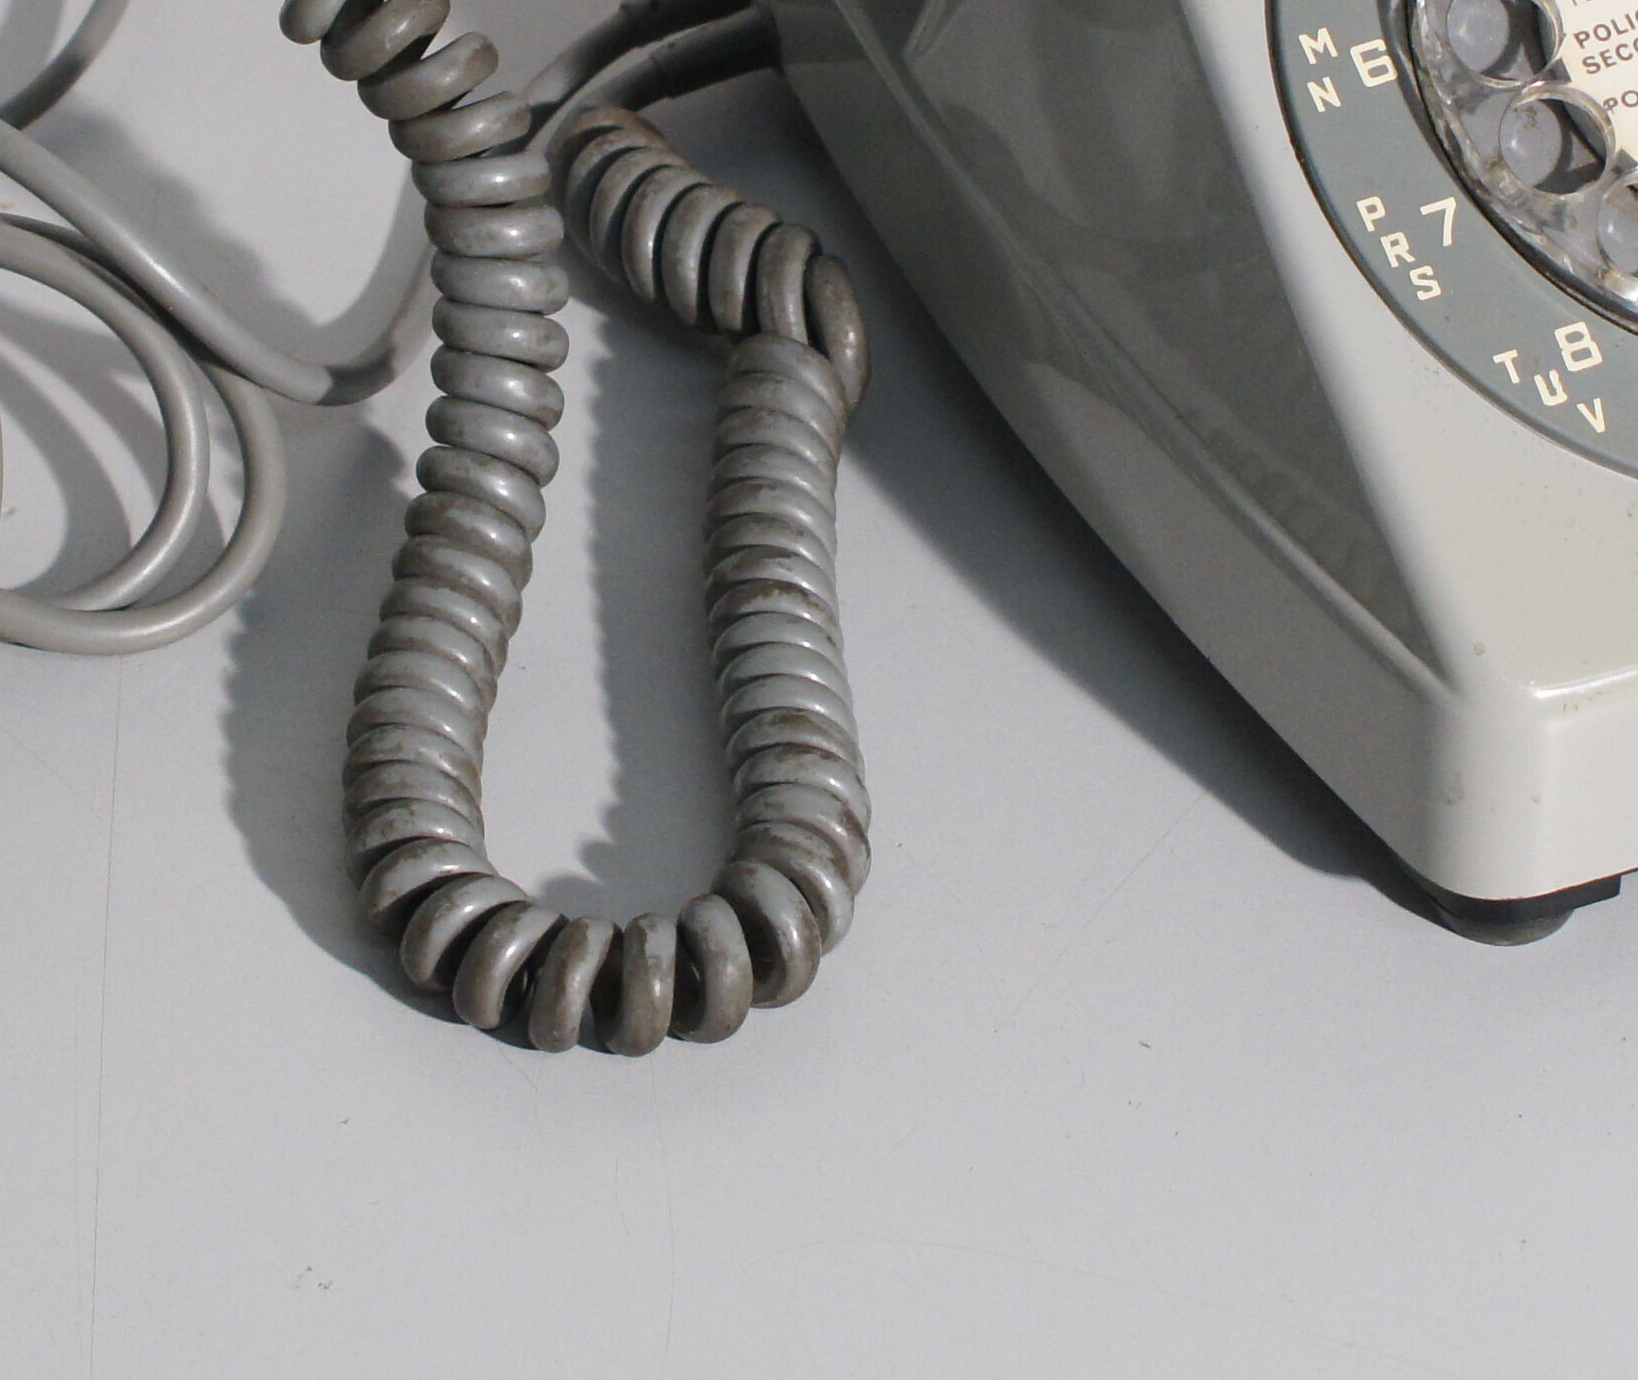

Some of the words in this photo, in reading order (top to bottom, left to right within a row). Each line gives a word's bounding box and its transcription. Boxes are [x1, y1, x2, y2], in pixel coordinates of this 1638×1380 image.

[1350, 38, 1398, 88] 6
[1420, 196, 1457, 247] 7
[1554, 321, 1603, 372] 8
